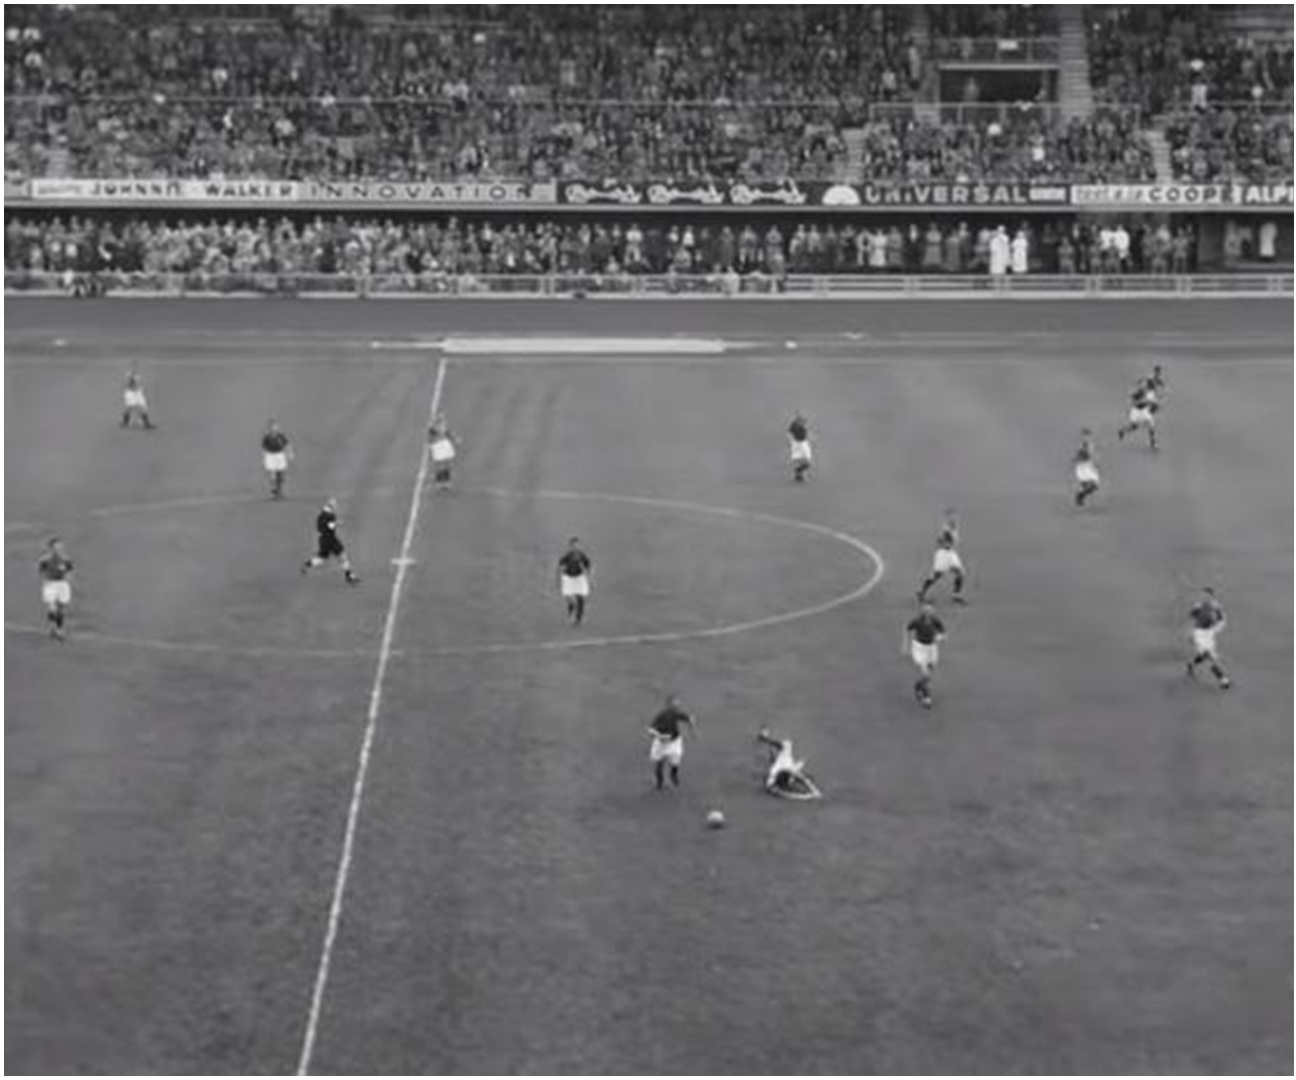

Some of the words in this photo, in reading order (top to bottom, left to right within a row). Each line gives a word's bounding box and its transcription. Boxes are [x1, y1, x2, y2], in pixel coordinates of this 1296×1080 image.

[311, 185, 532, 199] INNOVATION
[866, 185, 1026, 203] UNIVERSAL
[1149, 187, 1217, 201] COOP
